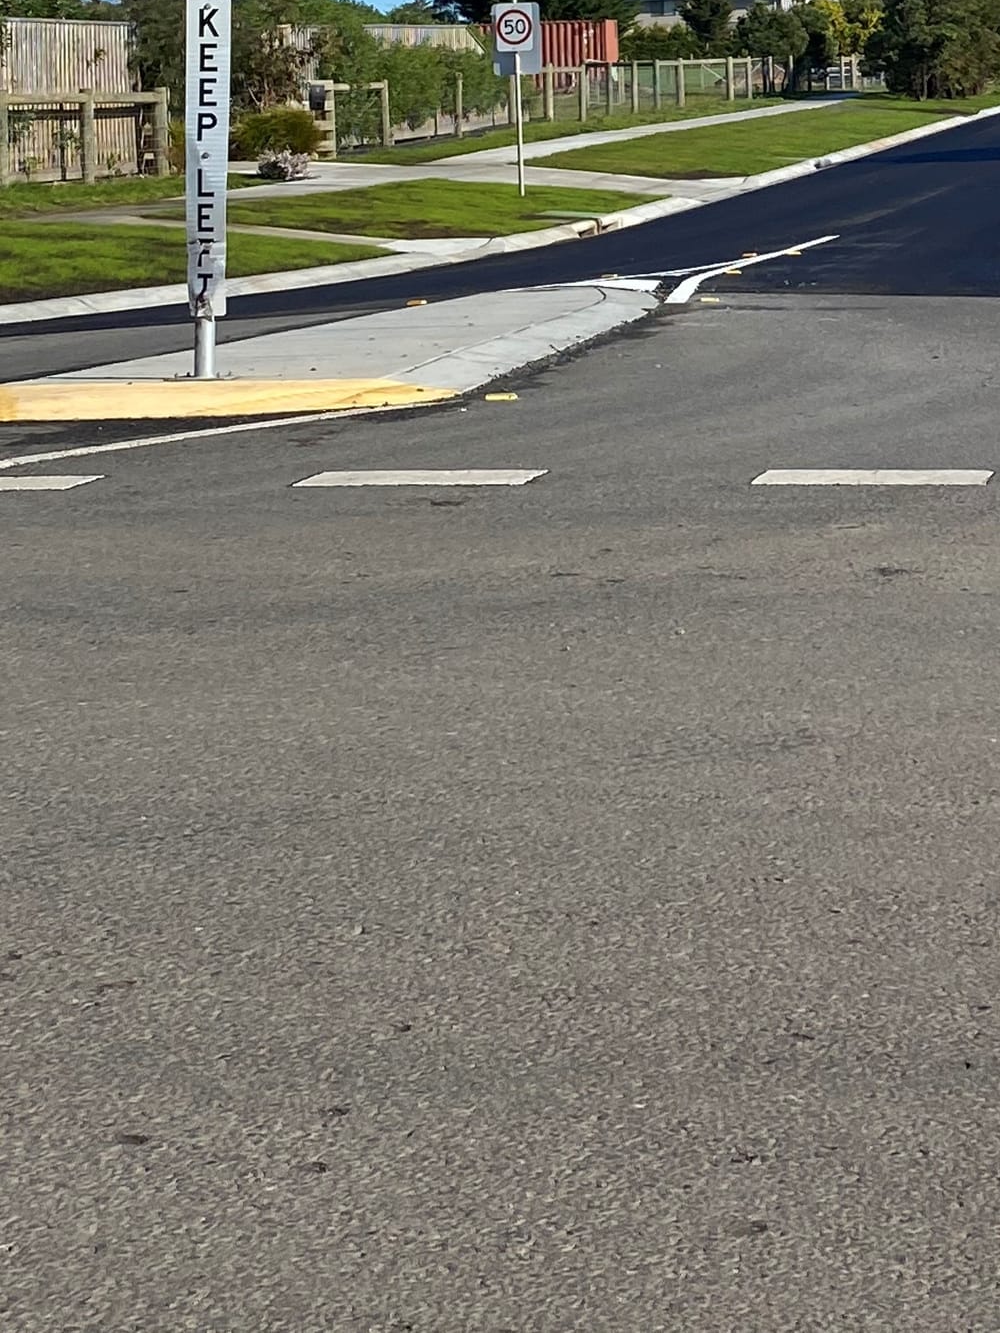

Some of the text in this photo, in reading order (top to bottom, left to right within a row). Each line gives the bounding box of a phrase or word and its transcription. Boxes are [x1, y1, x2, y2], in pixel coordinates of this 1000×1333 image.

[504, 19, 526, 35] 50
[197, 8, 219, 302] KEEP LEFT
